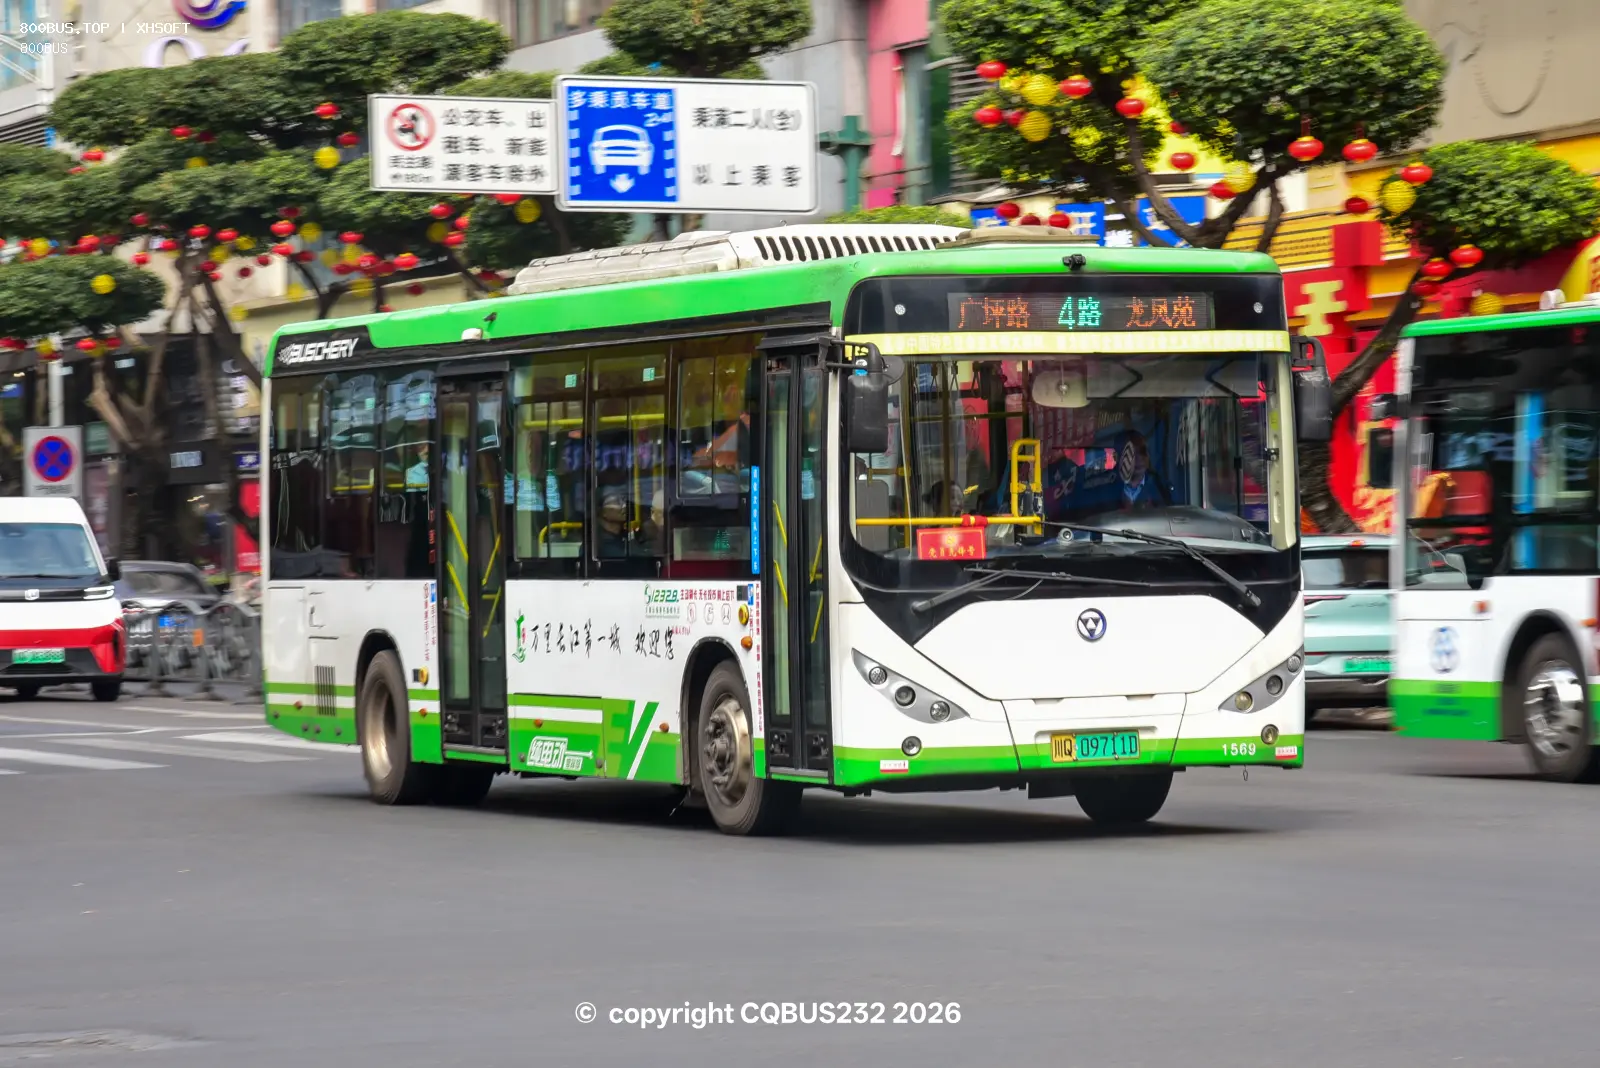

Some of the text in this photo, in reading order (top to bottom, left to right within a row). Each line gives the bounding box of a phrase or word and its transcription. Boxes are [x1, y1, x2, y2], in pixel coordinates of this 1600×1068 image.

[1057, 296, 1102, 330] 4路
[1125, 295, 1197, 328] 龙凤苑
[530, 618, 622, 659] 万里长江第一城
[1221, 743, 1256, 757] 1569
